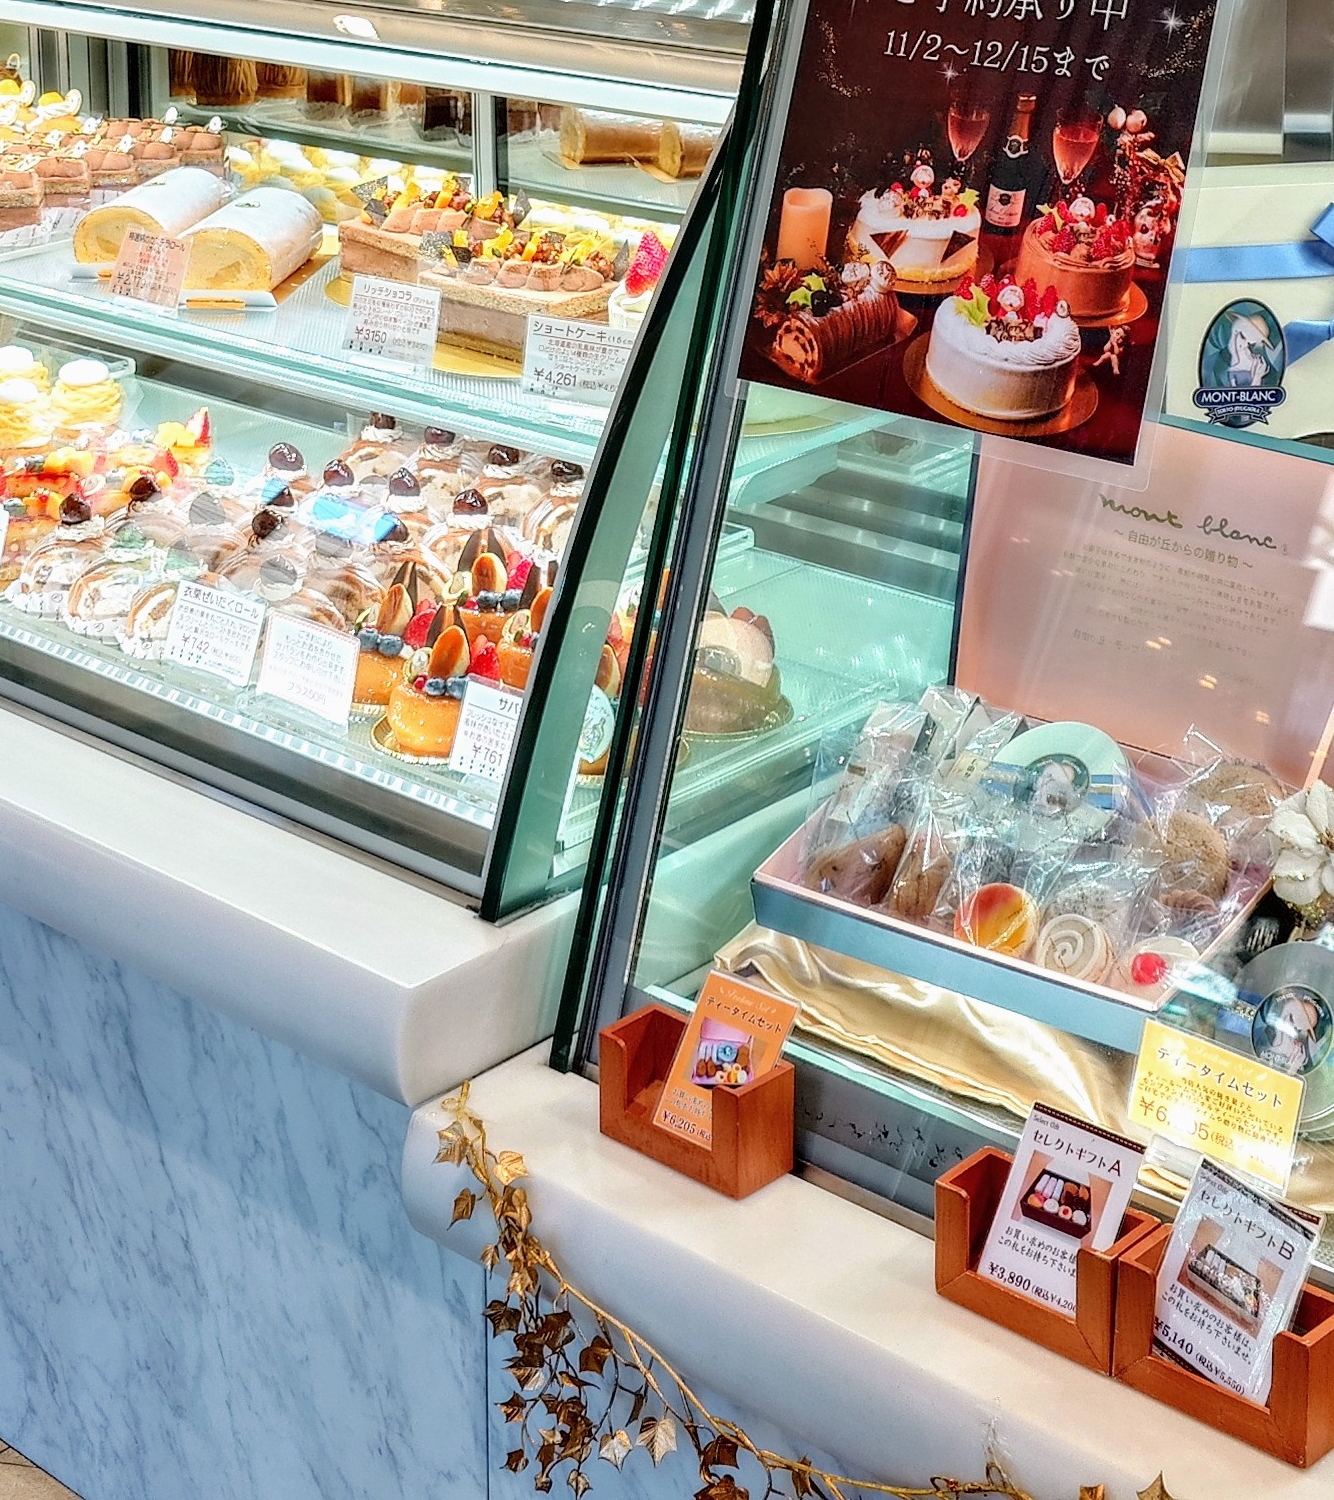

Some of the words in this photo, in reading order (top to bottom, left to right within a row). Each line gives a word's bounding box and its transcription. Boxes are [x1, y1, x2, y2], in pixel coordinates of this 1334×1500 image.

[363, 283, 413, 302] リッチショコラ
[533, 319, 606, 342] ショートケーキ
[1201, 390, 1276, 403] MONT-BLANC
[1099, 493, 1183, 529] mont
[1197, 515, 1277, 549] blanc
[705, 996, 783, 1034] ティータイムセット
[1158, 1047, 1282, 1108] ティータイムセット
[662, 1110, 697, 1135] ¥6,205
[1034, 1130, 1122, 1178] セレクトギフトA
[989, 1261, 1032, 1292] ¥3,890
[1153, 1317, 1194, 1356] ¥5,140
